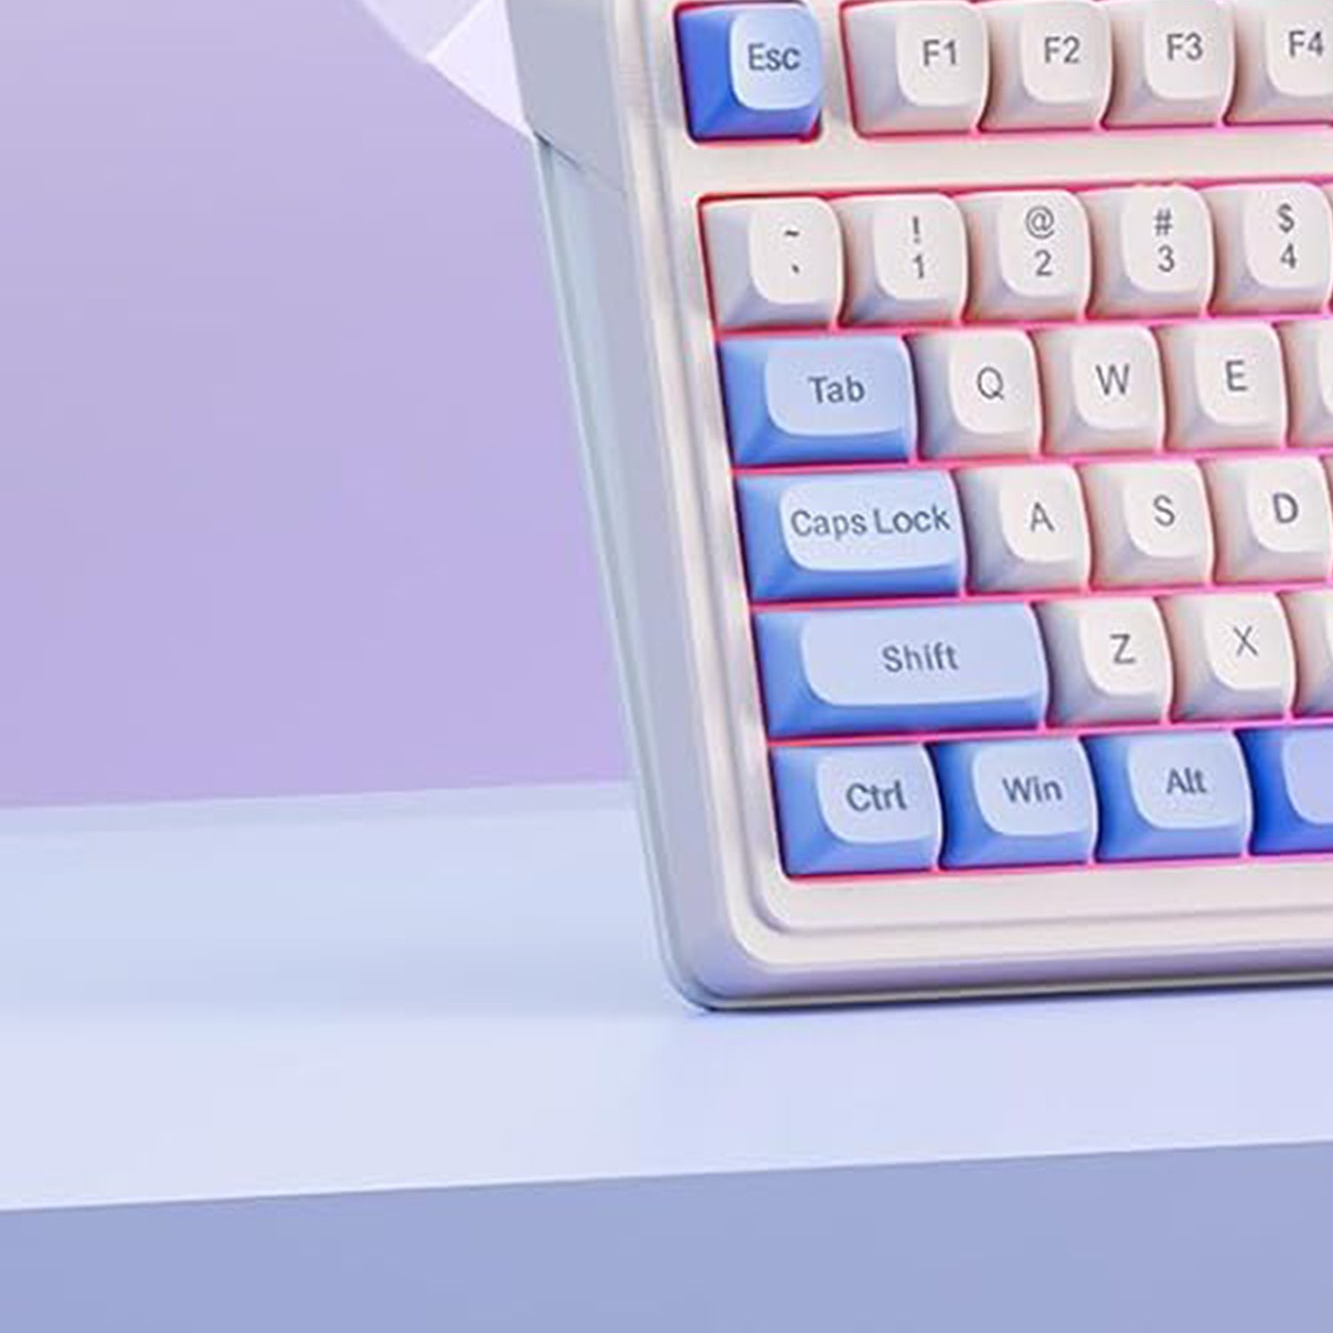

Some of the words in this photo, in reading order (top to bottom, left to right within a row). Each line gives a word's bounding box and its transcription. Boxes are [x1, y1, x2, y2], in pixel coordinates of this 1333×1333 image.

[748, 43, 800, 71] Esc
[923, 39, 956, 66] F1
[1045, 36, 1080, 63] F2
[1167, 32, 1203, 60] F3
[1289, 30, 1323, 57] F4
[913, 216, 919, 243] !
[1025, 206, 1054, 239] @
[1155, 210, 1172, 235] #
[1278, 204, 1294, 233] $
[914, 255, 924, 278] 1
[1035, 250, 1052, 276] 2
[1159, 245, 1175, 272] 3
[1281, 243, 1296, 268] 4
[808, 376, 865, 403] Tab
[977, 367, 1004, 399] Q
[1096, 364, 1129, 395] W
[1226, 360, 1247, 391] E
[1031, 502, 1054, 531] A
[1154, 495, 1175, 526] S
[1273, 493, 1298, 523] D
[791, 509, 867, 540] Caps
[874, 505, 950, 534] Lock
[1110, 634, 1135, 664] Z
[1233, 626, 1258, 655] X
[883, 642, 958, 672] Shift
[1002, 777, 1062, 802] Win
[1167, 768, 1207, 794] Alt
[846, 781, 907, 812] Ctrl
